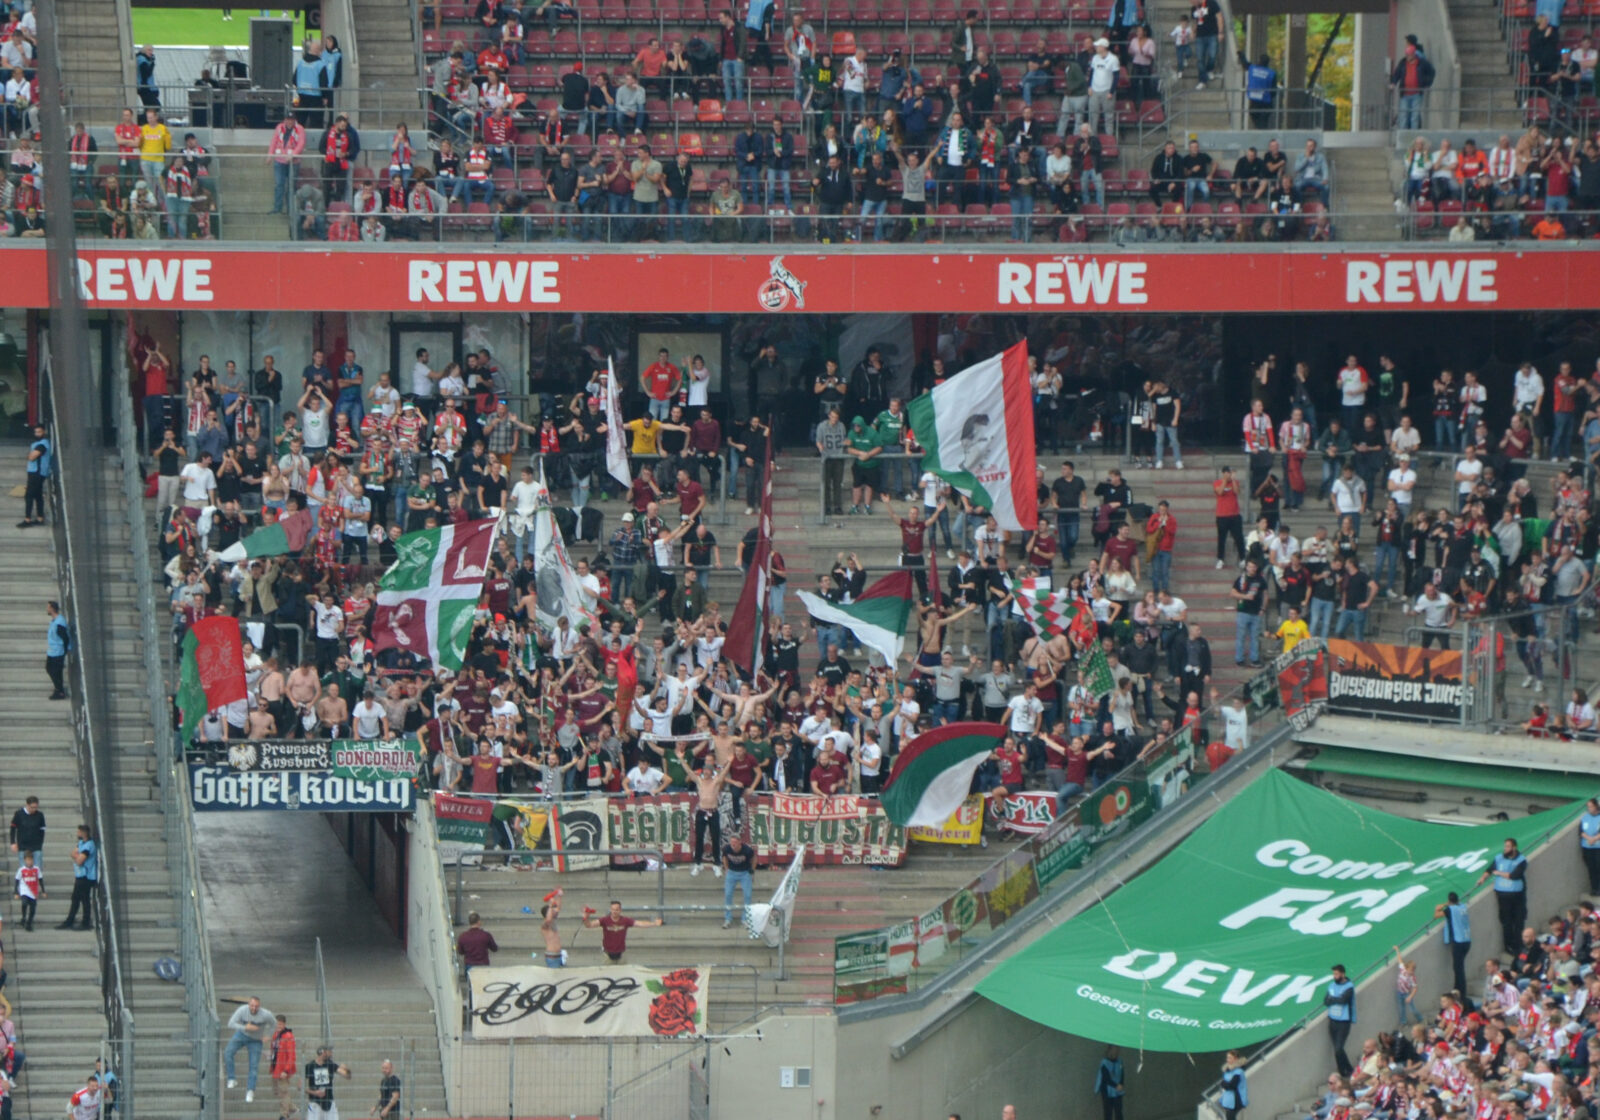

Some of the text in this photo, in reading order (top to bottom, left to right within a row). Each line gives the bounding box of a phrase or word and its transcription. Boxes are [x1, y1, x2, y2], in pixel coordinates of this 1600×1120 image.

[76, 258, 214, 302] REWE
[408, 259, 560, 303] REWE
[998, 260, 1148, 305] REWE
[1347, 259, 1498, 303] REWE
[336, 750, 416, 767] CONCORDIA
[776, 796, 857, 815] KICKERS
[608, 811, 906, 846] LEGIO AUGUSTA
[1256, 839, 1415, 880] Come
[1220, 884, 1430, 938] FC!
[1102, 948, 1333, 1007] DEVK
[1076, 984, 1140, 1015] Gesagt.
[1147, 1008, 1201, 1028] Getan.
